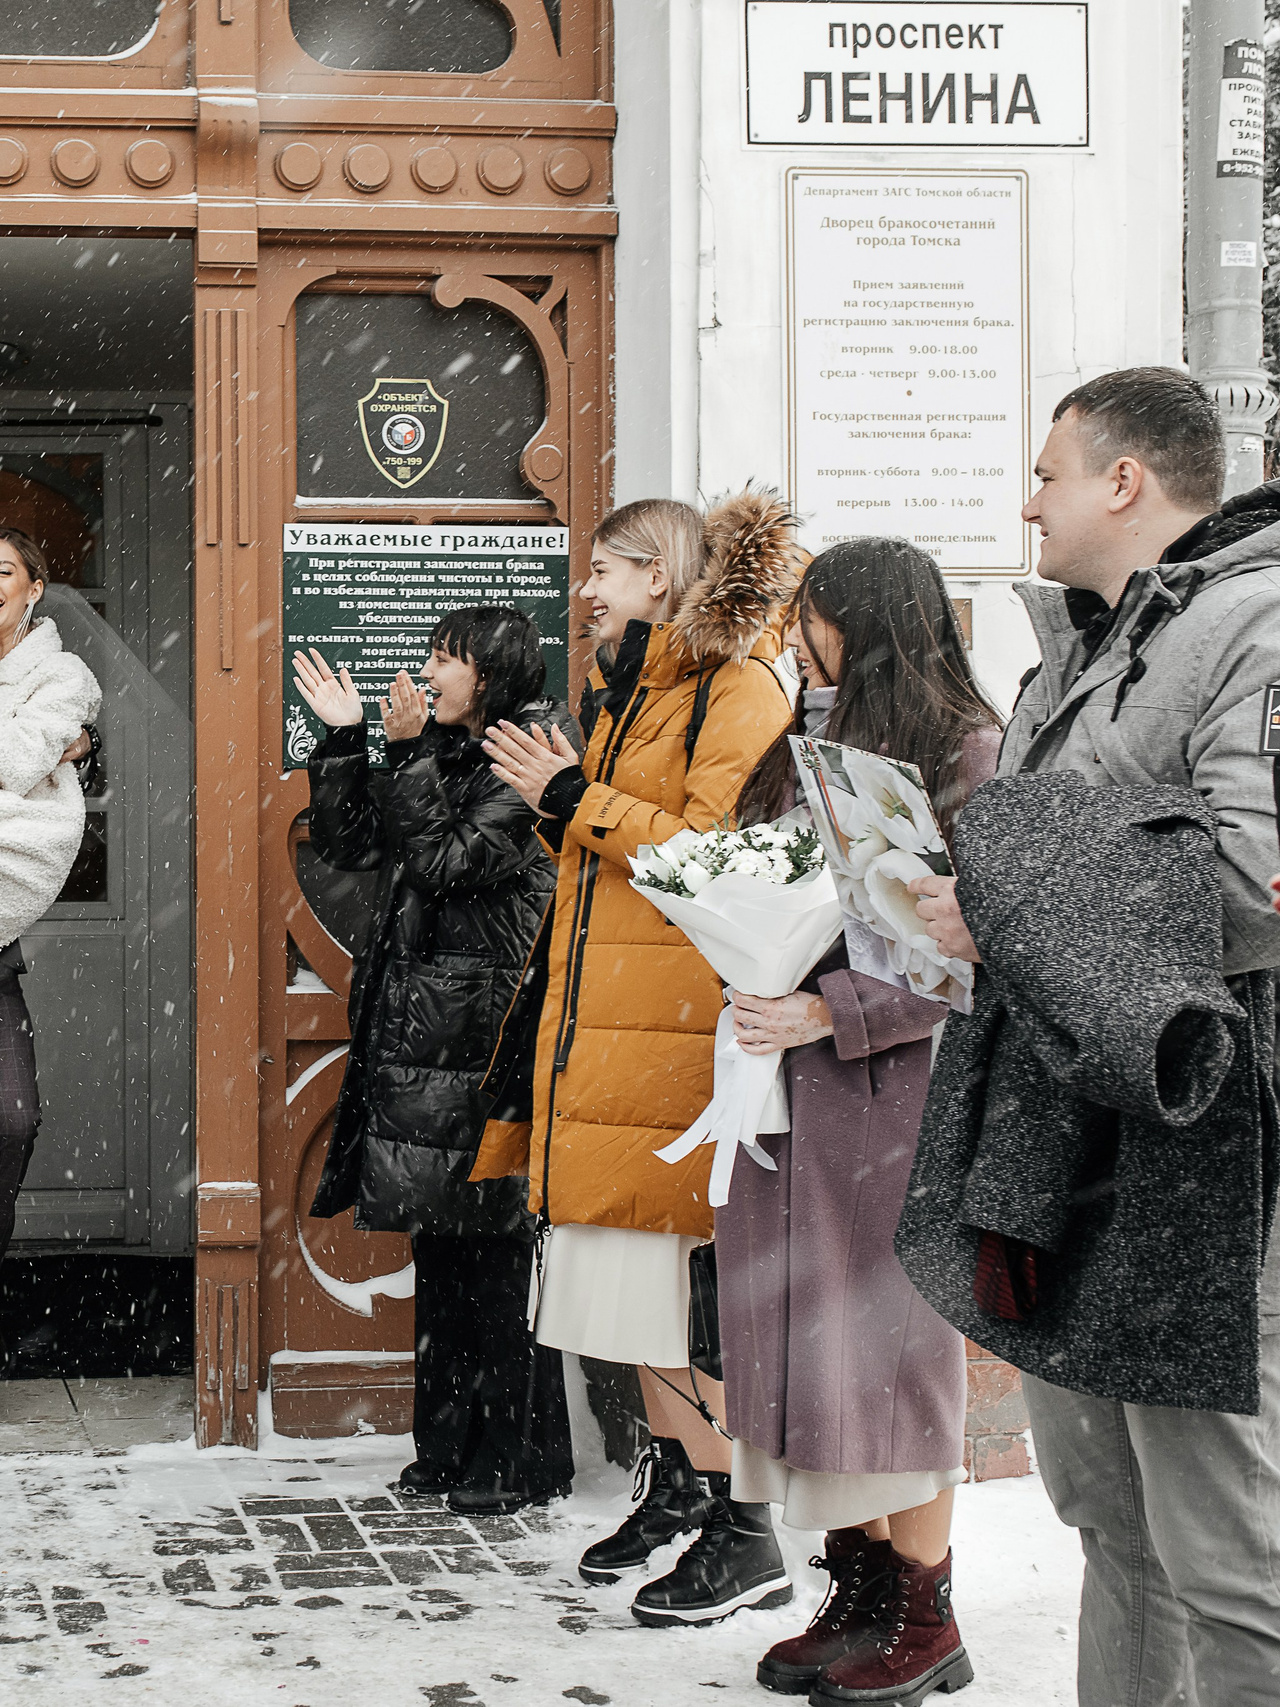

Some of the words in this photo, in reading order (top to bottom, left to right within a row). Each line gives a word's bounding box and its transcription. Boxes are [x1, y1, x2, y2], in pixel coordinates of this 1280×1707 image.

[828, 22, 1004, 59] проспект
[797, 71, 1041, 125] ЛЕНИНА
[803, 186, 879, 198] Департамент
[882, 187, 911, 197] ЗАГС
[915, 187, 963, 198] Томской
[966, 187, 1012, 198] области
[819, 216, 874, 231] Дворец
[878, 215, 996, 232] бракосочетаний
[856, 236, 906, 249] города
[910, 234, 961, 247] Томска
[852, 280, 894, 291] Прием
[898, 280, 965, 291] заявлений
[843, 300, 858, 308] на
[862, 299, 975, 311] государственную
[803, 317, 888, 328] регистрацию
[891, 318, 969, 328] заключения
[973, 316, 1015, 329] брака.
[841, 345, 894, 355] вторник
[819, 369, 857, 380] среда
[869, 370, 920, 381] четверг
[382, 393, 424, 402] ОБЪЕКТ
[370, 404, 437, 413] ОХРАНЯЕТСЯ
[812, 411, 922, 424] Государственная
[926, 413, 1007, 424] регистрация
[847, 430, 926, 439] заключения
[930, 428, 972, 441] брака:
[931, 467, 958, 477] 9.00
[972, 467, 1005, 477] 18.00
[836, 499, 891, 509] перерыв
[904, 498, 938, 507] 13.00
[951, 498, 984, 507] 14.00
[289, 529, 432, 547] Уважаемые
[440, 533, 565, 552] граждане!
[914, 534, 997, 545] понедельник
[308, 557, 335, 571] При
[337, 560, 421, 571] регистрации
[424, 560, 503, 570] заключения
[506, 558, 545, 572] брака
[302, 573, 311, 581] в
[313, 573, 352, 583] целях
[354, 570, 435, 585] соблюдения
[438, 574, 493, 583] чистоты
[495, 575, 504, 583] в
[506, 575, 551, 586] городе
[292, 586, 301, 595] и
[304, 586, 321, 595] во
[323, 583, 396, 596] избежание
[398, 587, 482, 598] травматизма
[484, 588, 510, 600] при
[512, 589, 561, 599] выходе
[339, 600, 355, 609] из
[357, 600, 432, 611] помещения
[358, 611, 441, 625] убедительно
[288, 634, 304, 643] не
[306, 634, 363, 643] осыпать
[361, 648, 430, 657] монетами,
[336, 660, 350, 668] не
[354, 657, 423, 672] разбивать
